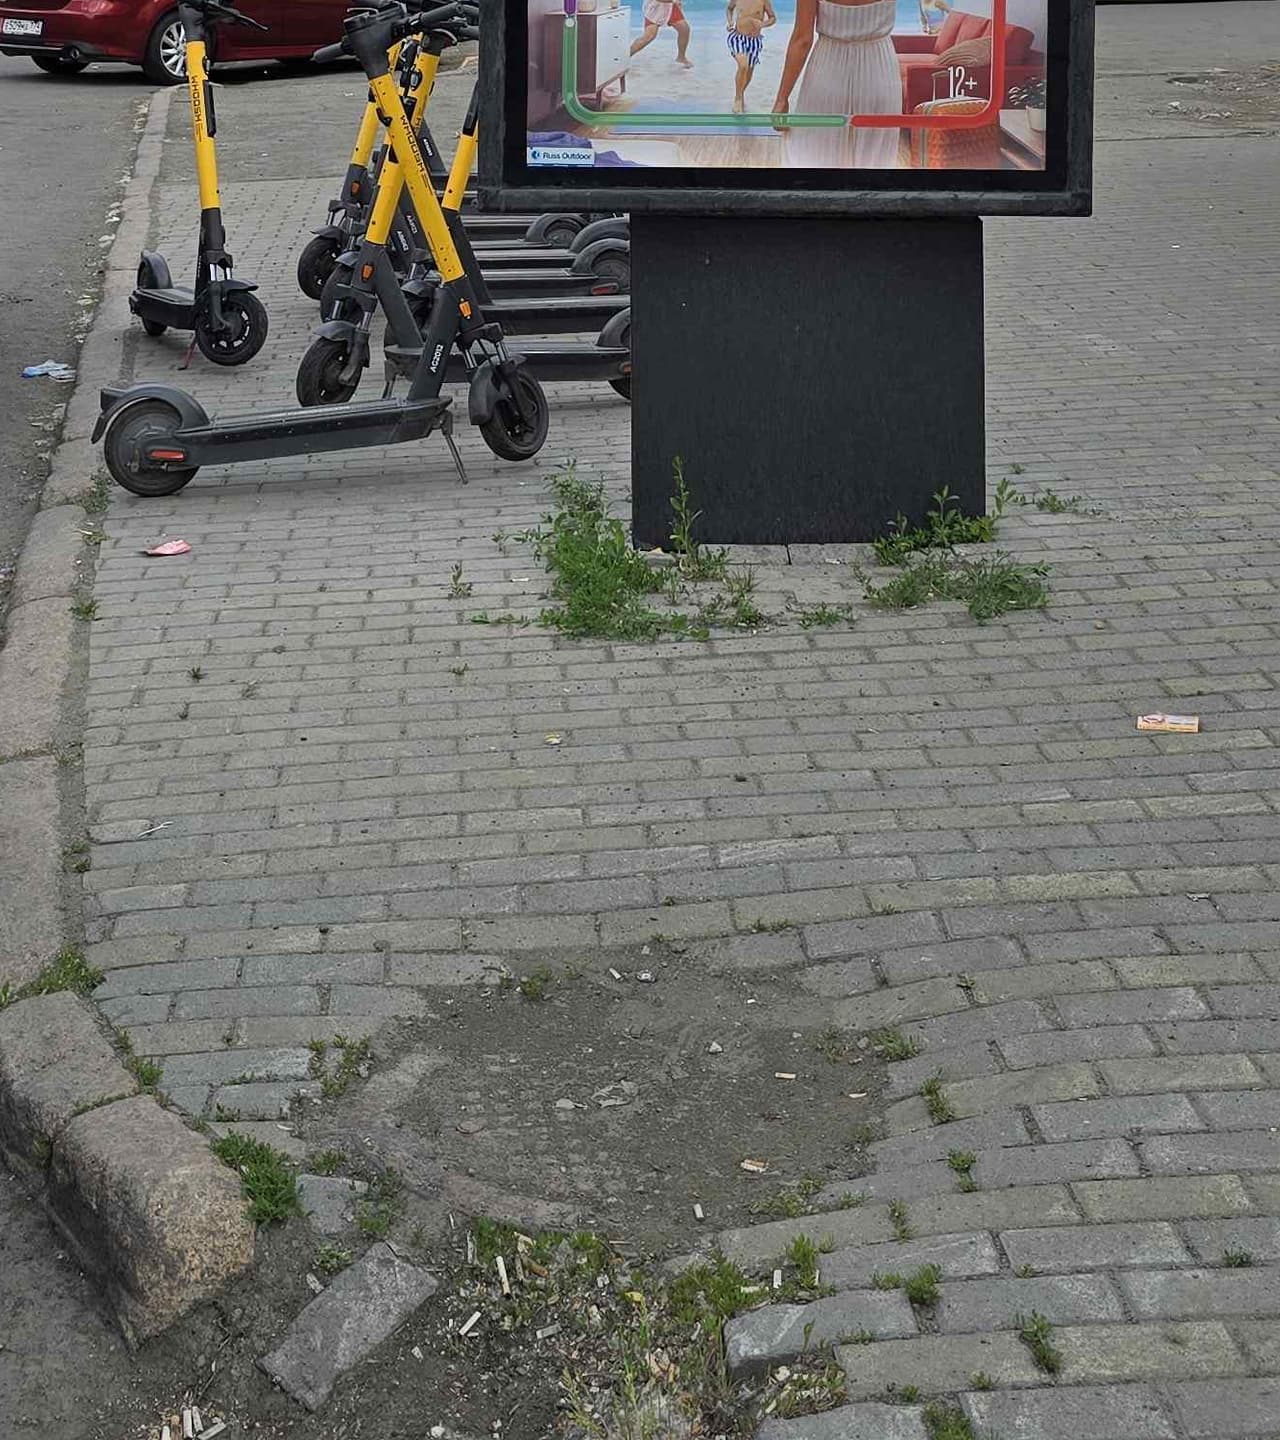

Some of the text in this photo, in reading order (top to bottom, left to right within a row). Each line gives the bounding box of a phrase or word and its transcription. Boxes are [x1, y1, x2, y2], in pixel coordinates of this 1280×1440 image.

[948, 66, 978, 98] 12+
[542, 152, 591, 160] Russ Outdoor
